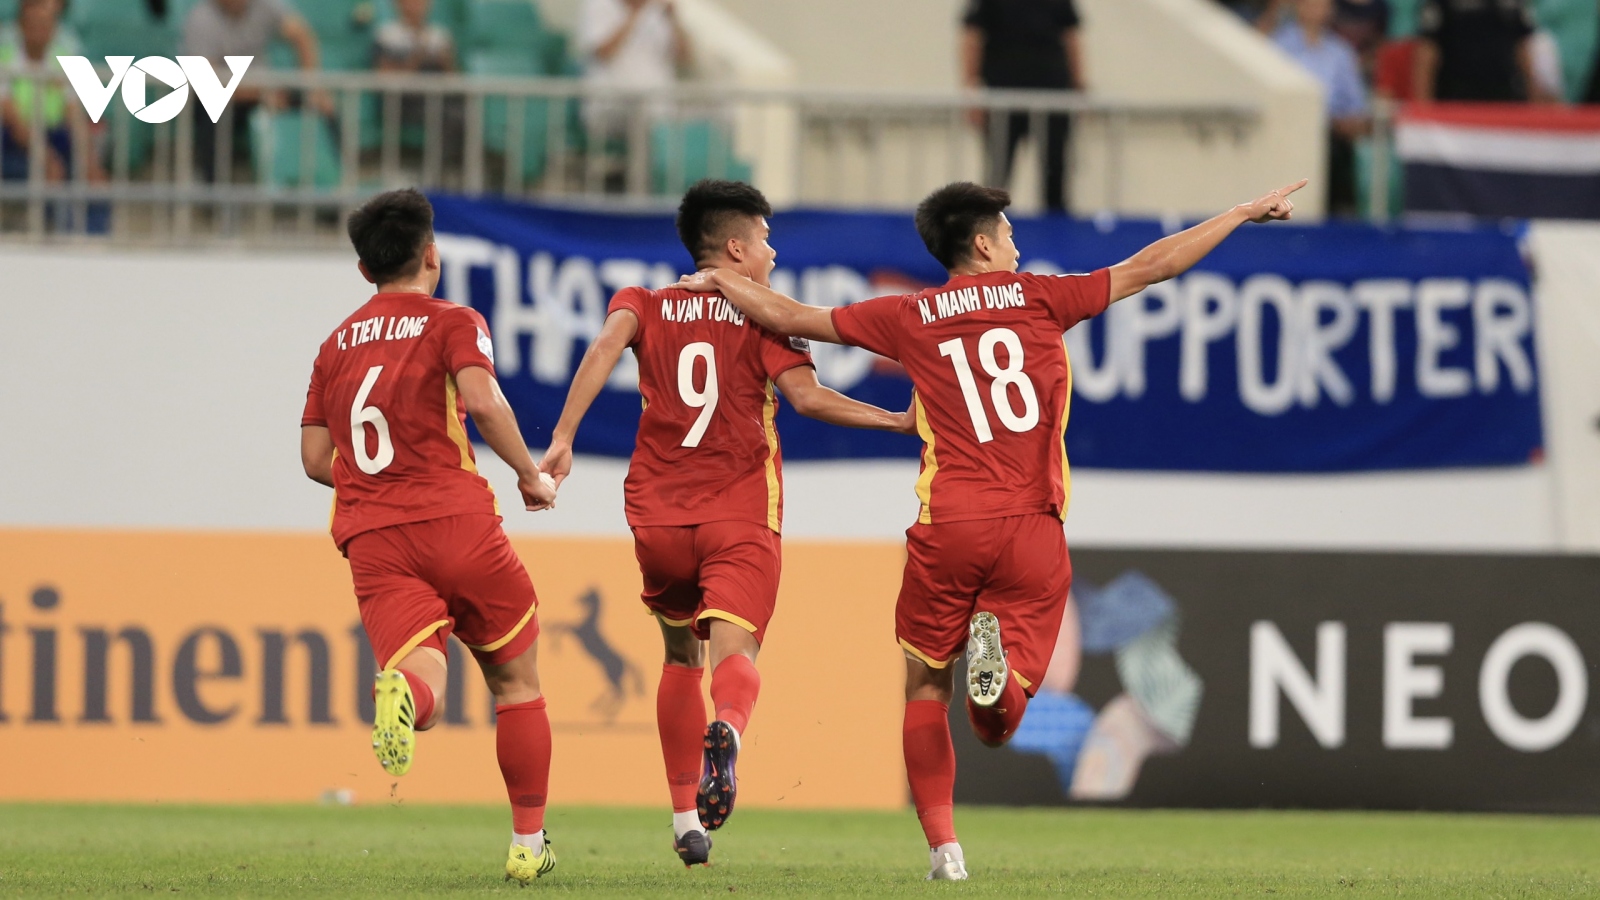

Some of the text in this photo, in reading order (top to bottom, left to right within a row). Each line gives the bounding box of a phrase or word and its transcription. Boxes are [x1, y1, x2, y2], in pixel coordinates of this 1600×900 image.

[351, 316, 385, 347] TIEN
[384, 315, 429, 341] LONG
[706, 296, 746, 327] TUNG
[934, 286, 982, 319] MANH
[982, 282, 1026, 310] DUNG
[1019, 259, 1535, 416] UPPORTER
[350, 365, 395, 475] 6
[677, 341, 719, 448] 9
[937, 327, 1040, 444] 18
[1248, 620, 1589, 752] NEO
